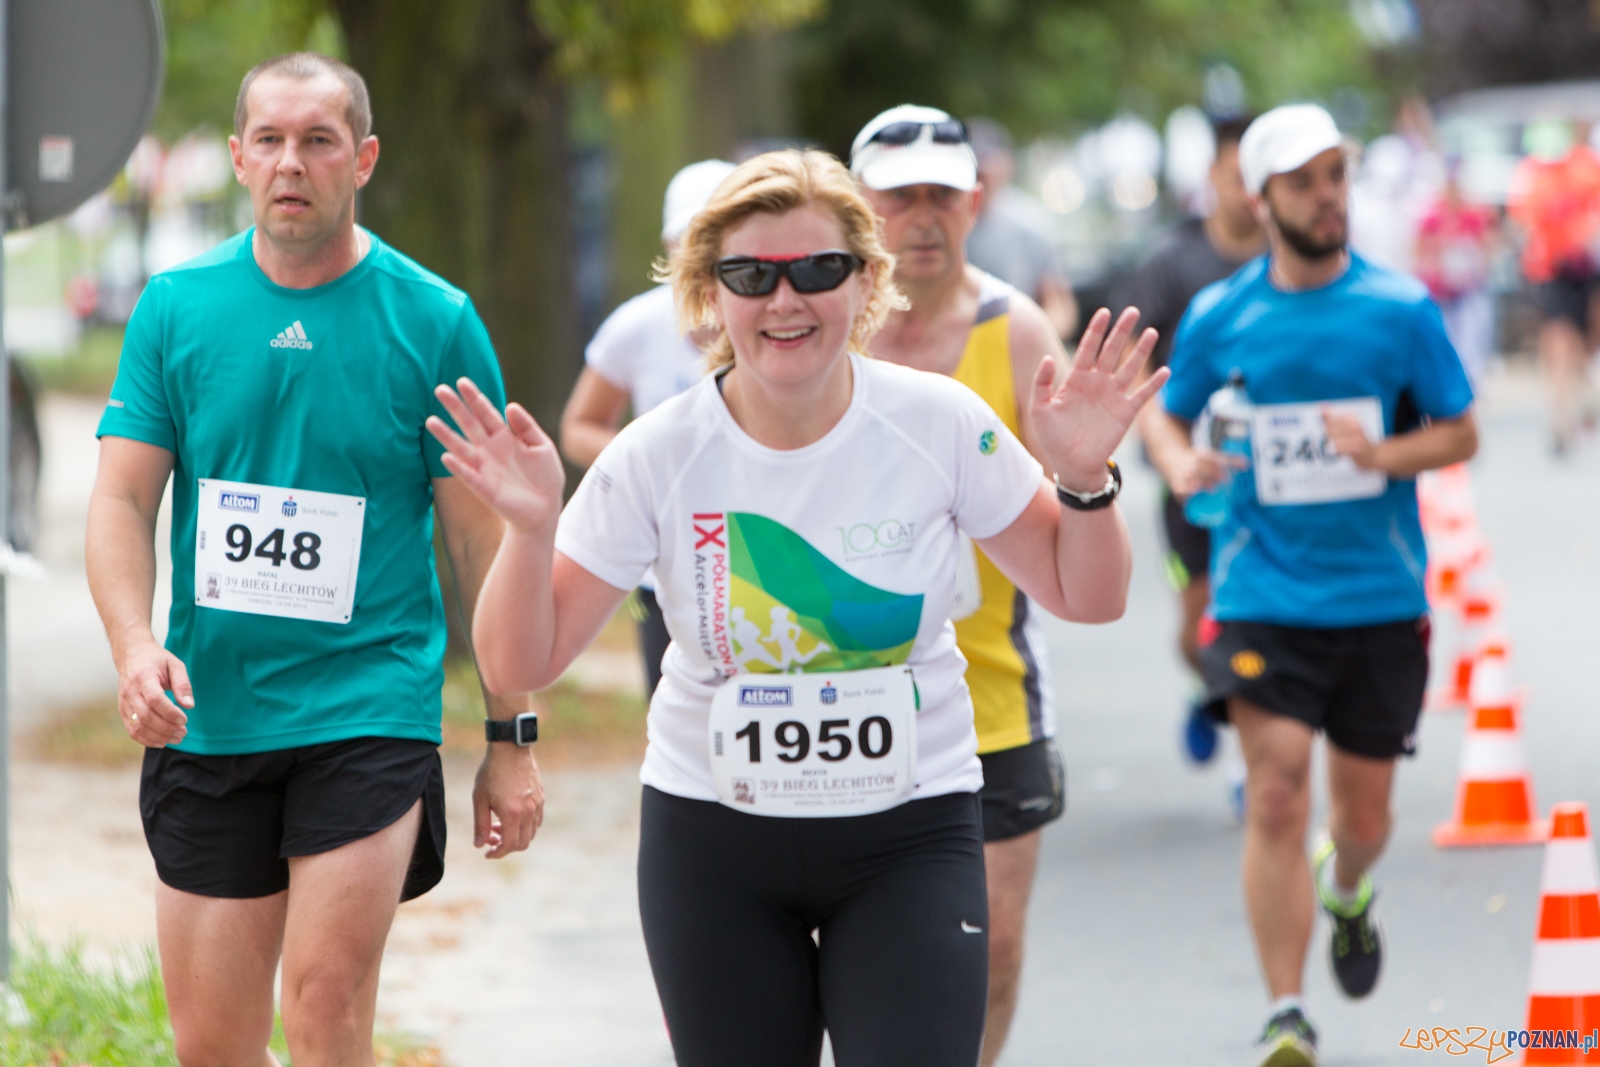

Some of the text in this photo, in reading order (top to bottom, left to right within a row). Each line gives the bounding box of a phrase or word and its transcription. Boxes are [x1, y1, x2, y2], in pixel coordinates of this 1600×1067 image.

[270, 338, 313, 350] adidas
[225, 523, 322, 571] 948
[692, 512, 726, 550] IX
[836, 519, 903, 555] 100
[887, 523, 917, 541] LAT
[224, 575, 238, 588] 39
[241, 578, 269, 591] BIEG
[273, 581, 338, 599] LECHITÓW
[711, 553, 734, 665] PÓŁMARATON
[735, 715, 893, 764] 1950
[759, 771, 898, 792] 39 BIEG LECHITÓW
